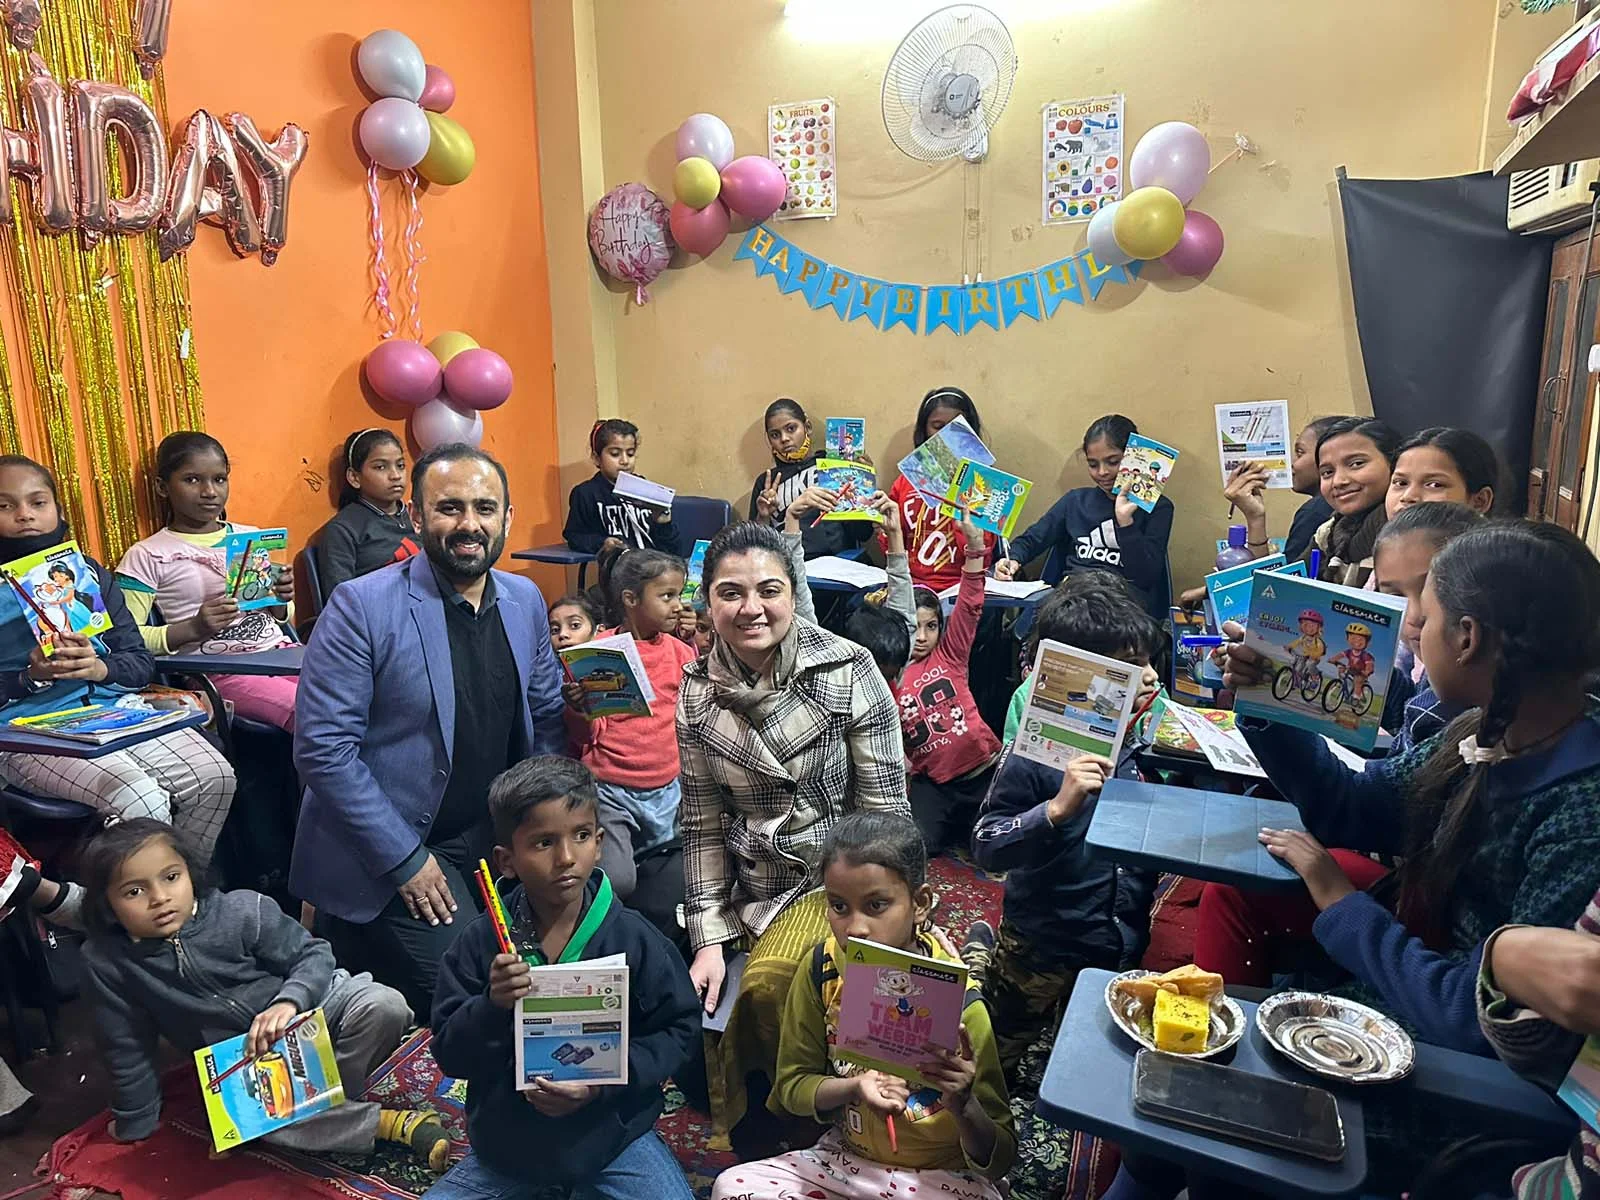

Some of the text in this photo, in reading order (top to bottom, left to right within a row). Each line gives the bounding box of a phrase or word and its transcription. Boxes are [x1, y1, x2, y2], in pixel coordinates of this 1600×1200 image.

[789, 108, 814, 118] FRUITS
[1058, 103, 1110, 118] COLOURS
[600, 201, 642, 232] Happy
[596, 228, 653, 264] Birthday
[1258, 612, 1286, 623] ENJOY
[1333, 602, 1387, 625] classmate
[913, 665, 948, 688] COOL
[911, 966, 955, 981] classmate
